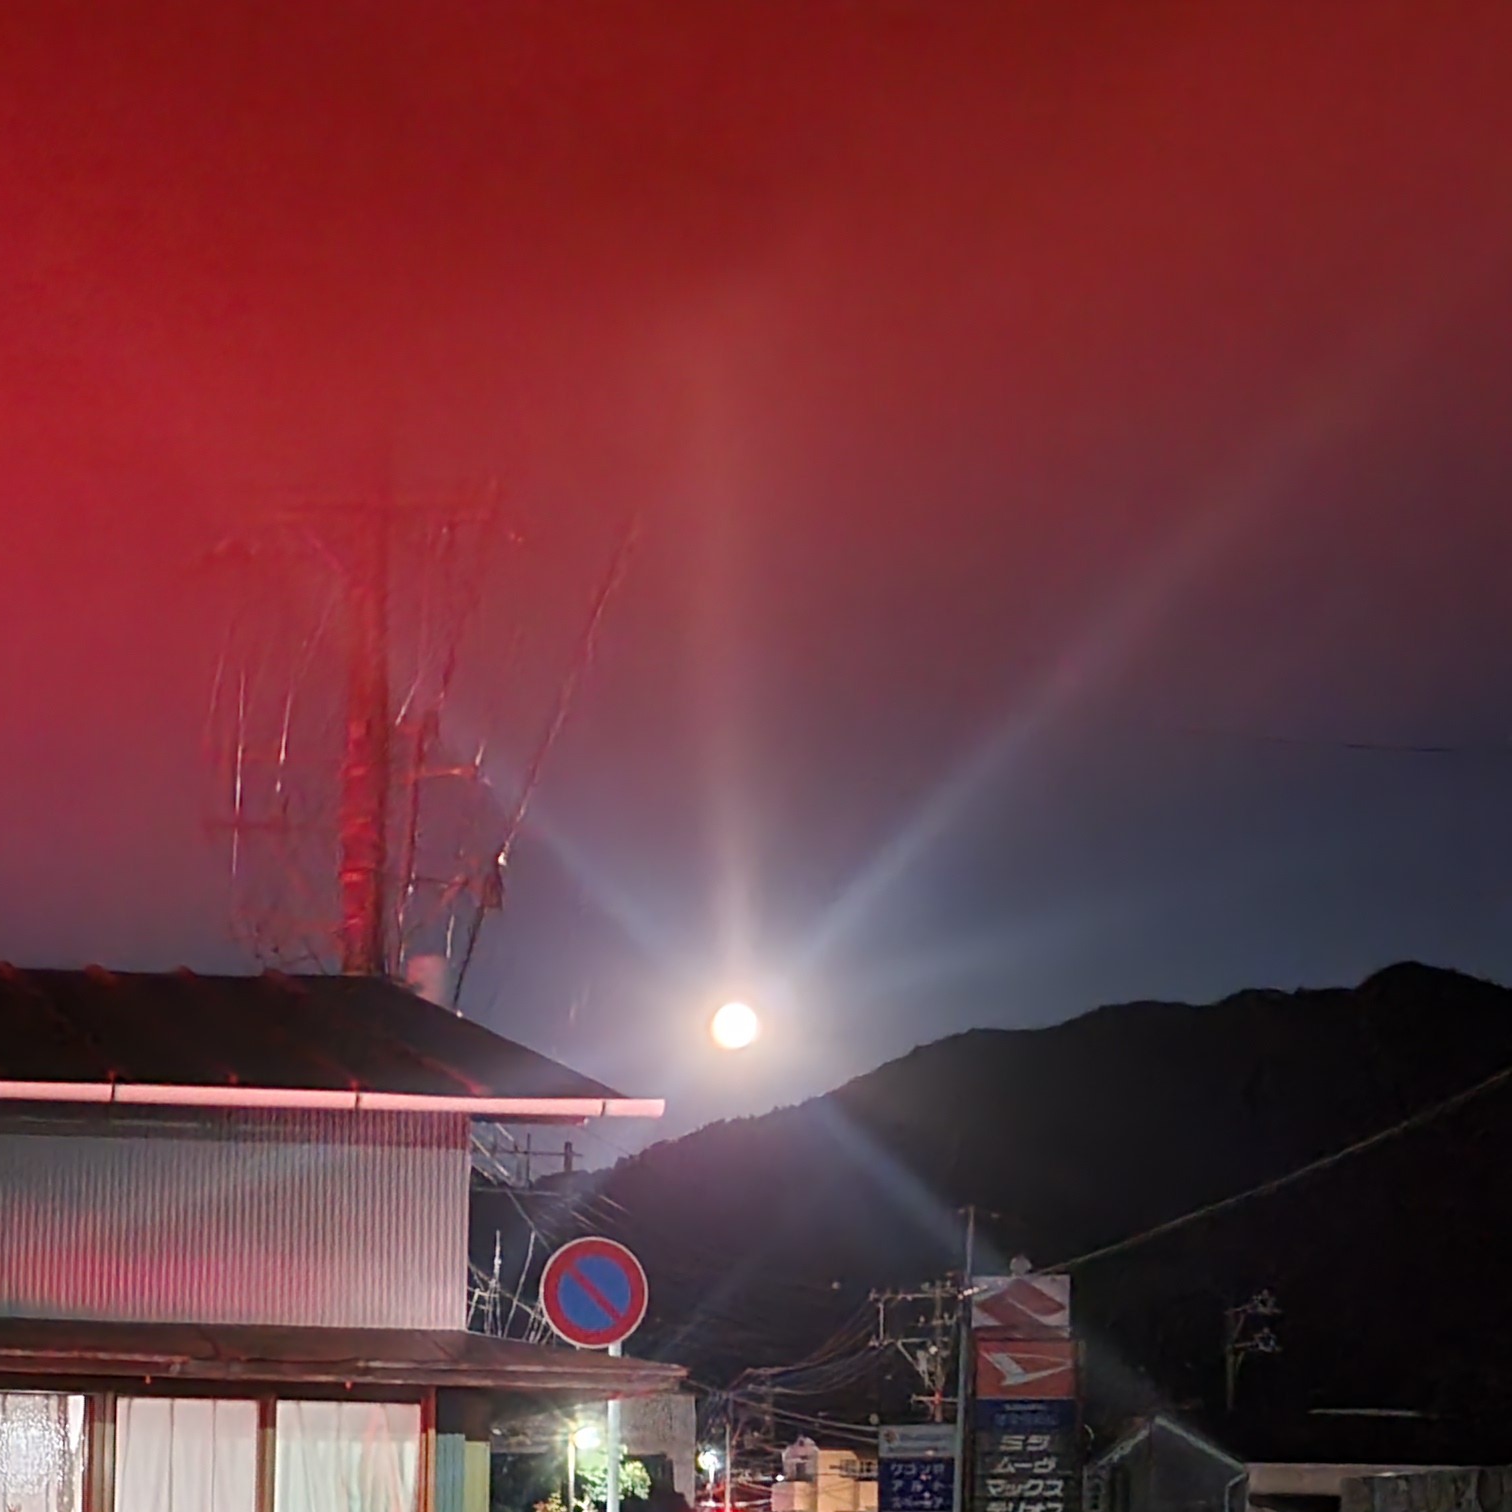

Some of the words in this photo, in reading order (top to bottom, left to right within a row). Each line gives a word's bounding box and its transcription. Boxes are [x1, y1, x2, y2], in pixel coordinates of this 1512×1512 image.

[989, 1456, 1057, 1474] ムーヴ
[985, 1479, 1064, 1497] マックス
